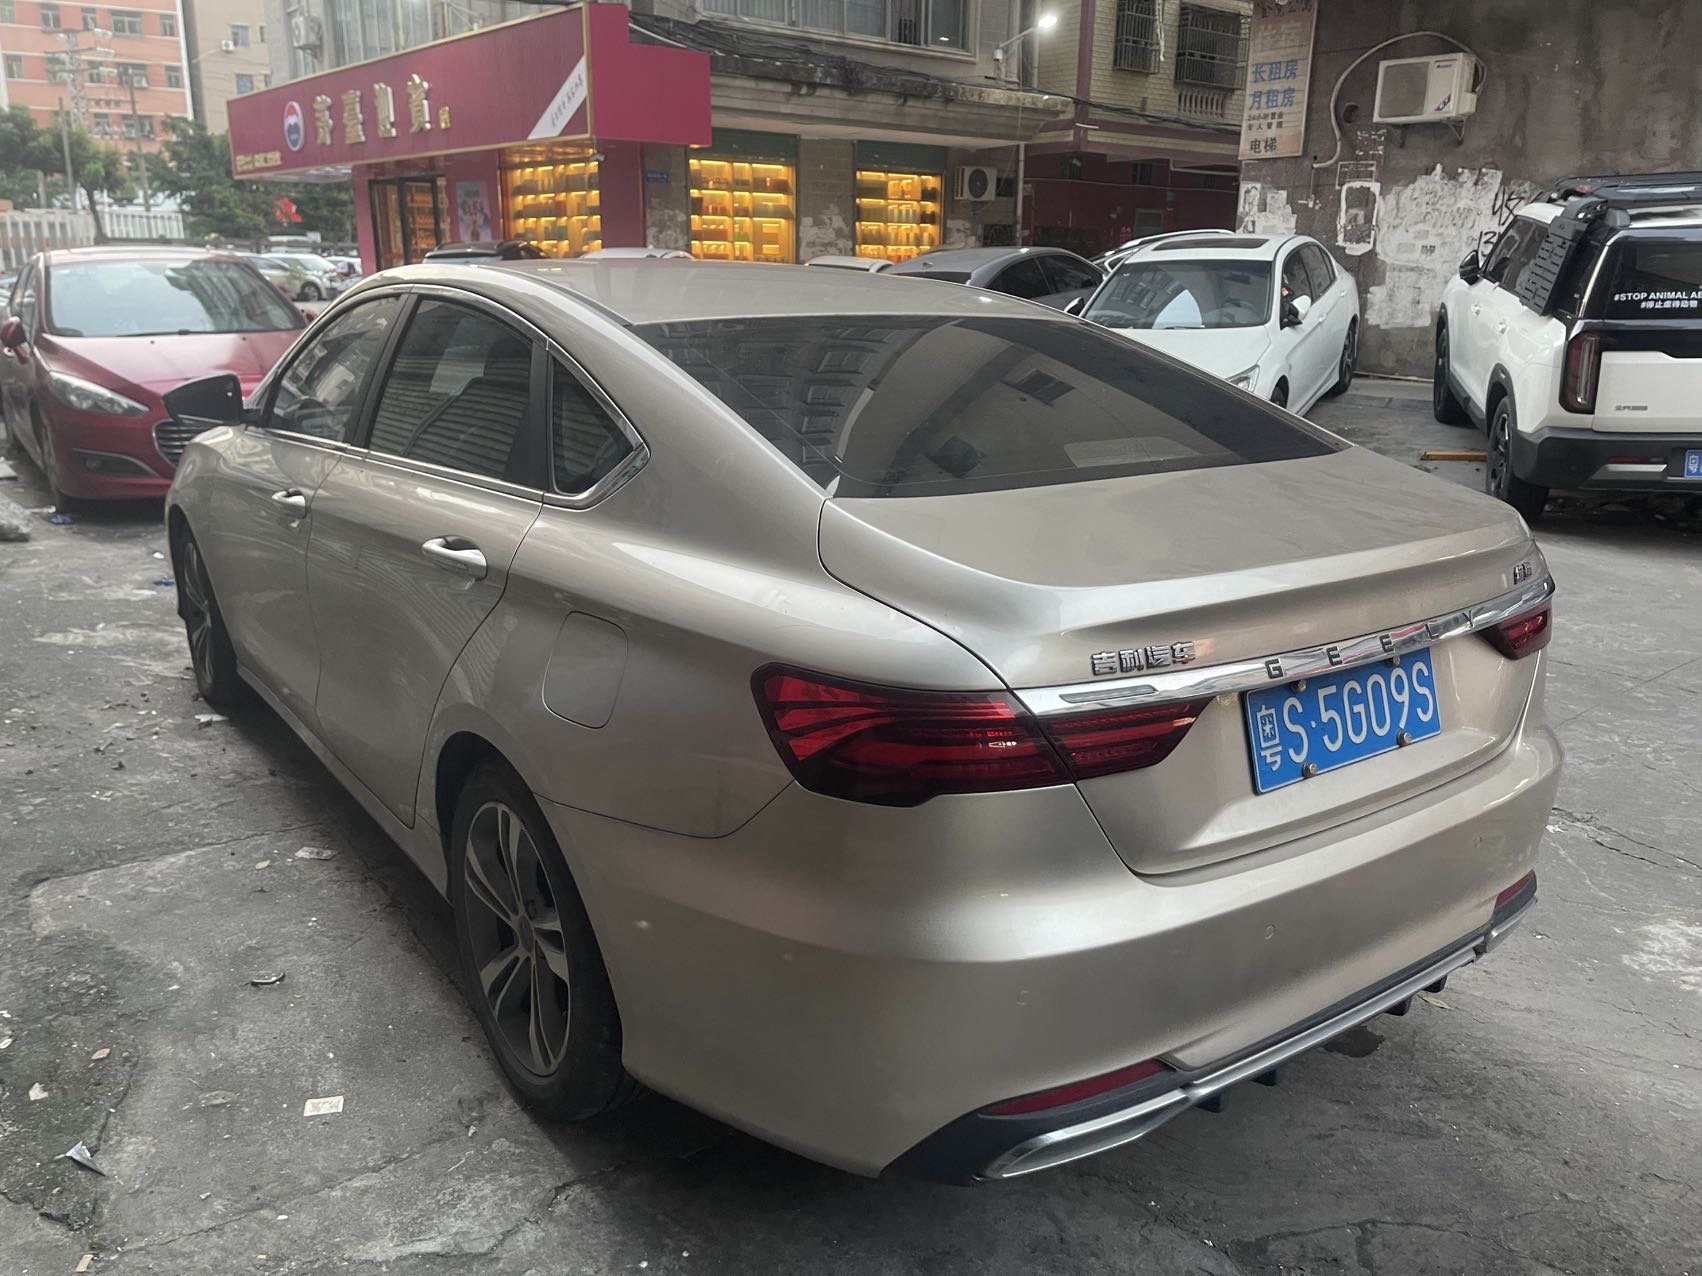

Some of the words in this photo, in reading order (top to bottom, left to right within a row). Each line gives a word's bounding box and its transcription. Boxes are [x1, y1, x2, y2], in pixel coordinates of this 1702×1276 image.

[1252, 59, 1298, 83] 长租房
[1249, 87, 1296, 110] 月租房
[1250, 137, 1277, 153] 电梯
[1614, 292, 1648, 301] #STOP
[1649, 291, 1689, 300] ANIMAL
[1091, 641, 1196, 676] 吉利汽车
